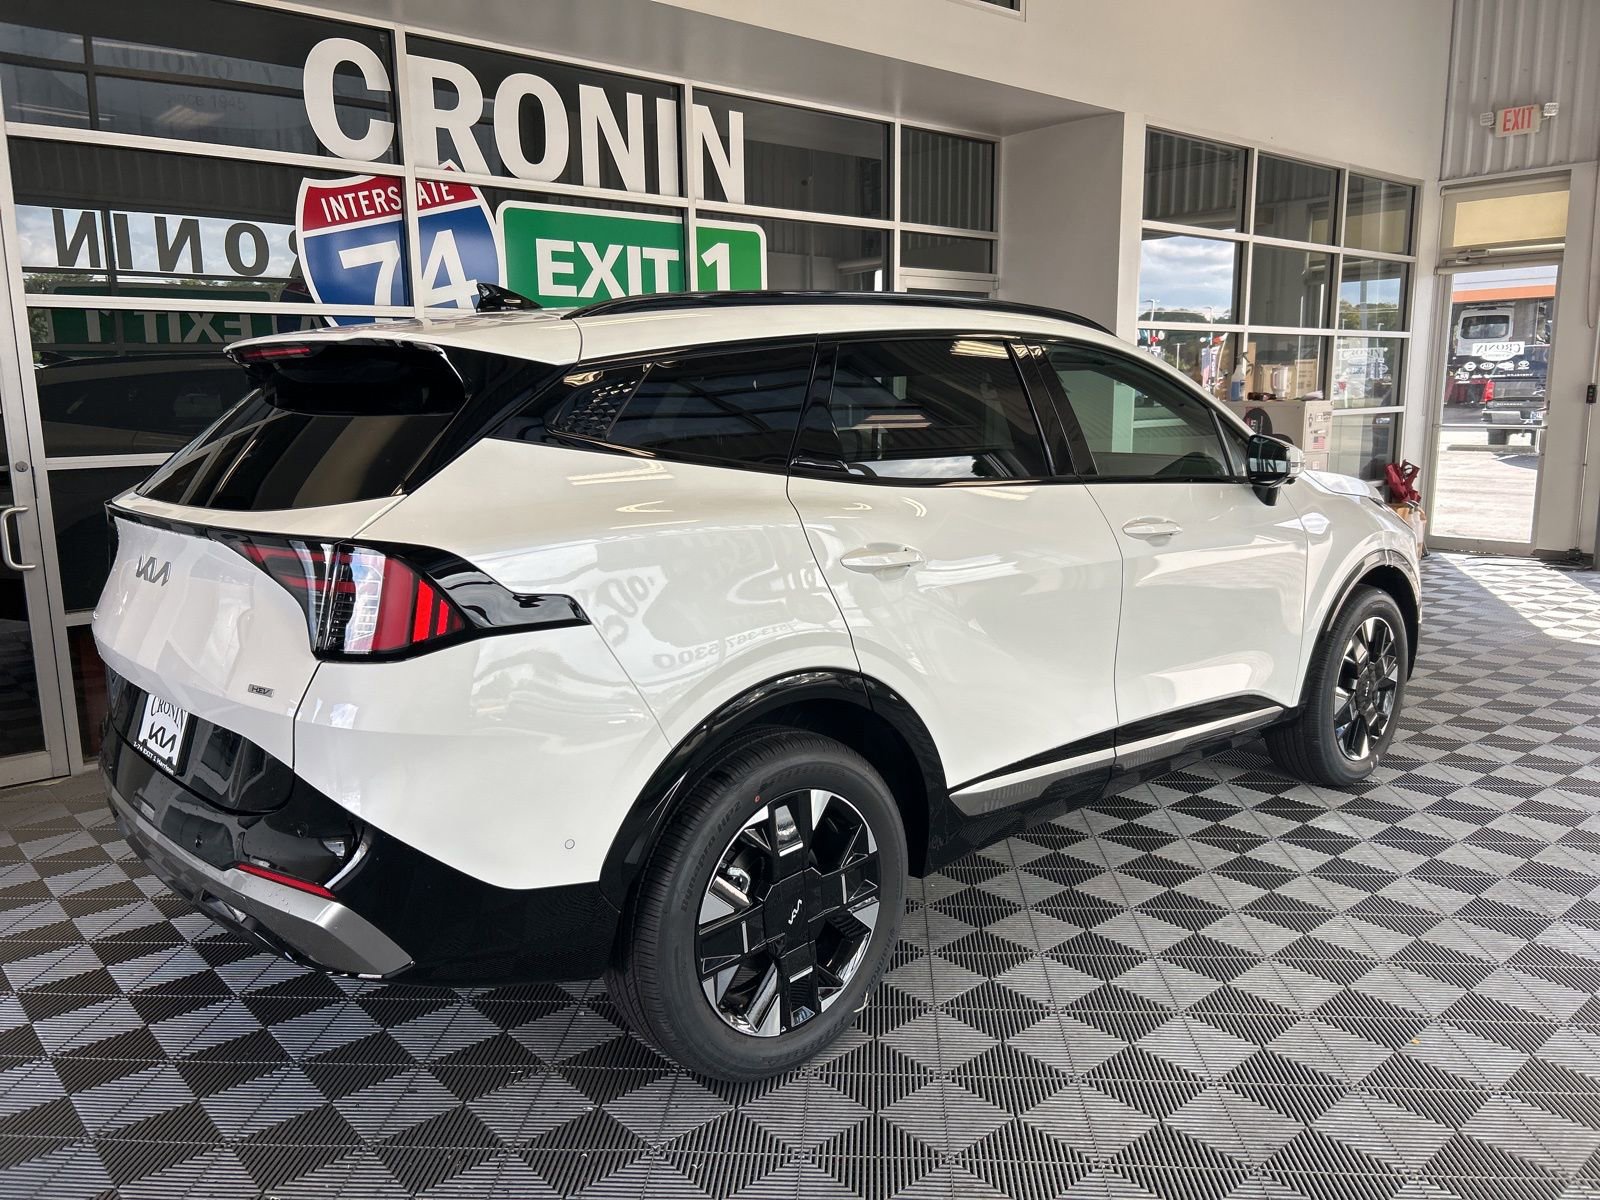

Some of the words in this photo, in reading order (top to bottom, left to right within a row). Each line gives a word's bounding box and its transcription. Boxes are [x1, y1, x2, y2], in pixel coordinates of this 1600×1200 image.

[303, 37, 745, 205] CRONIN
[1503, 106, 1534, 132] EXIT
[320, 180, 455, 223] INTERSATE
[338, 229, 478, 322] 74
[536, 238, 679, 299] EXIT
[701, 243, 731, 291] 1
[136, 555, 171, 587] KIA
[151, 696, 184, 728] CRONIN
[148, 721, 177, 754] KIA
